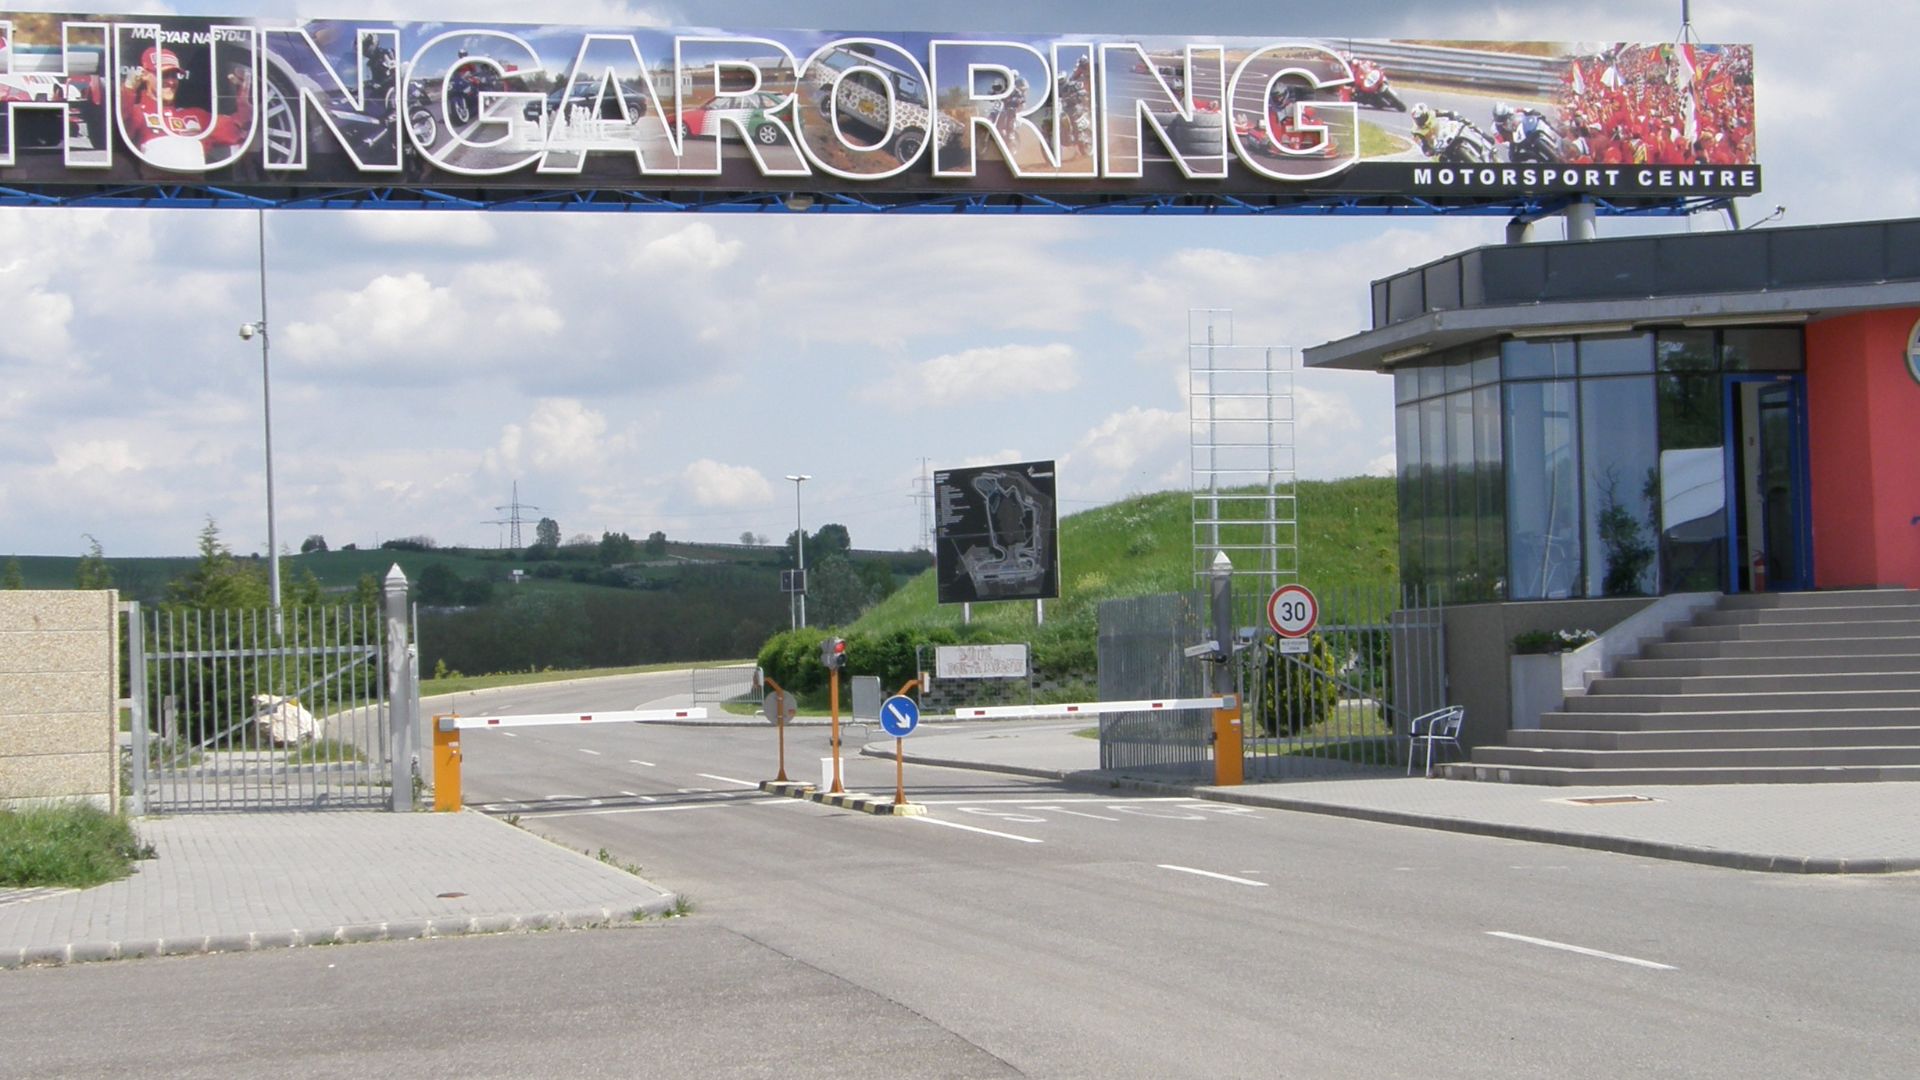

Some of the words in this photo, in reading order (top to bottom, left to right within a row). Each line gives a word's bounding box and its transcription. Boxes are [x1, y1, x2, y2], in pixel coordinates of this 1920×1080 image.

[0, 20, 1359, 182] HUNGARORING
[1413, 167, 1620, 186] MOTORSPORT
[1638, 169, 1755, 187] CENTRE
[1281, 601, 1306, 622] 30
